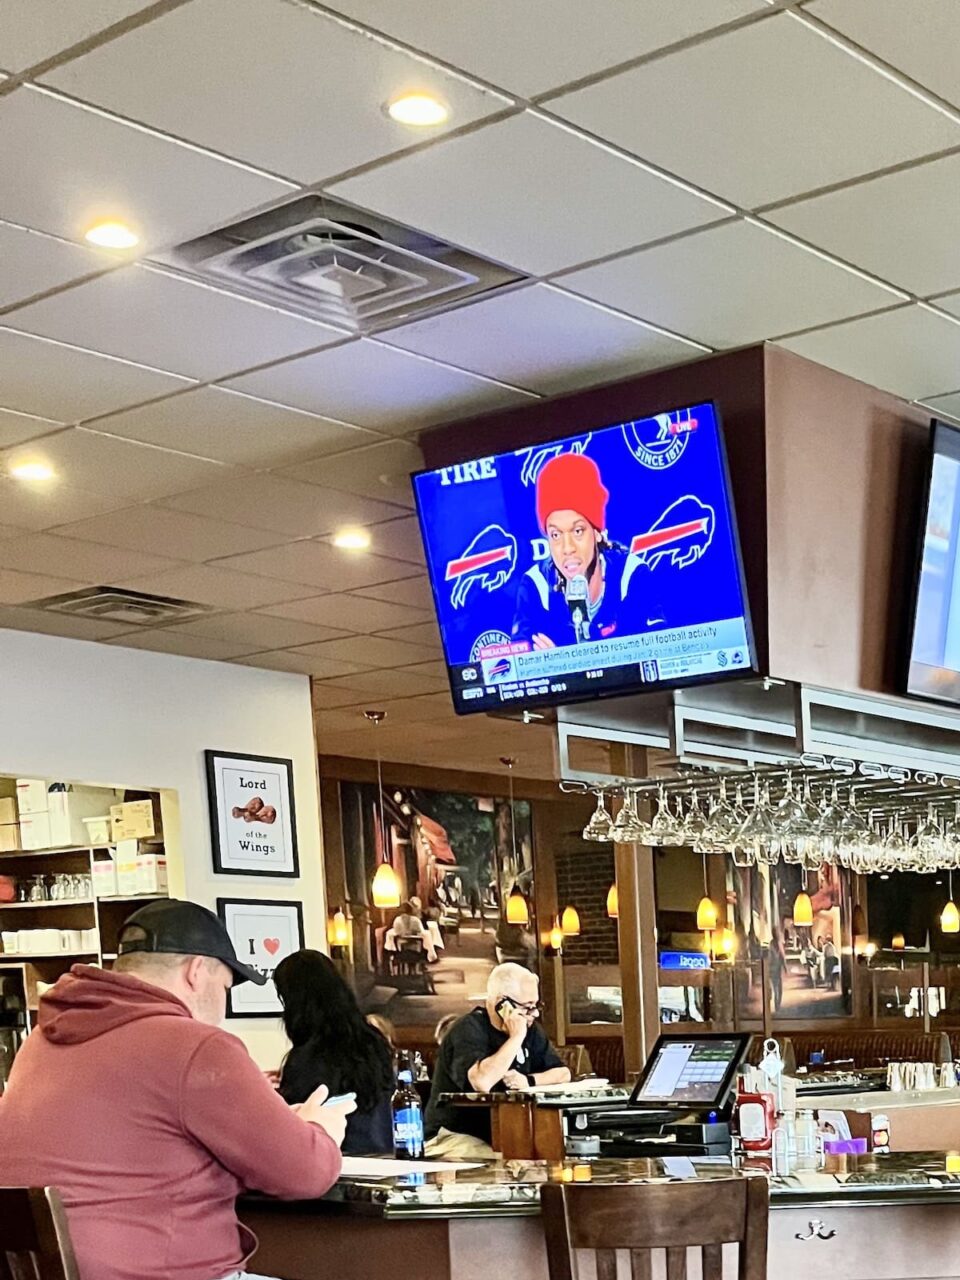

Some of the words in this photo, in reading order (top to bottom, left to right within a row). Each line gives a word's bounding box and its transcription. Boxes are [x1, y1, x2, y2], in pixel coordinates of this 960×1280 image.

[676, 421, 693, 433] LIVE
[635, 446, 665, 466] SINCE
[665, 439, 683, 463] 1871
[435, 456, 497, 486] TIRE
[518, 655, 542, 666] Damar
[544, 650, 570, 662] Hamlin
[571, 644, 600, 658] cleared
[611, 639, 641, 650] resume
[641, 635, 654, 647] full
[655, 630, 687, 644] football
[688, 626, 717, 639] activity
[239, 777, 267, 790] Lord
[245, 830, 254, 838] of
[238, 840, 276, 855] Wings
[248, 938, 256, 955] I
